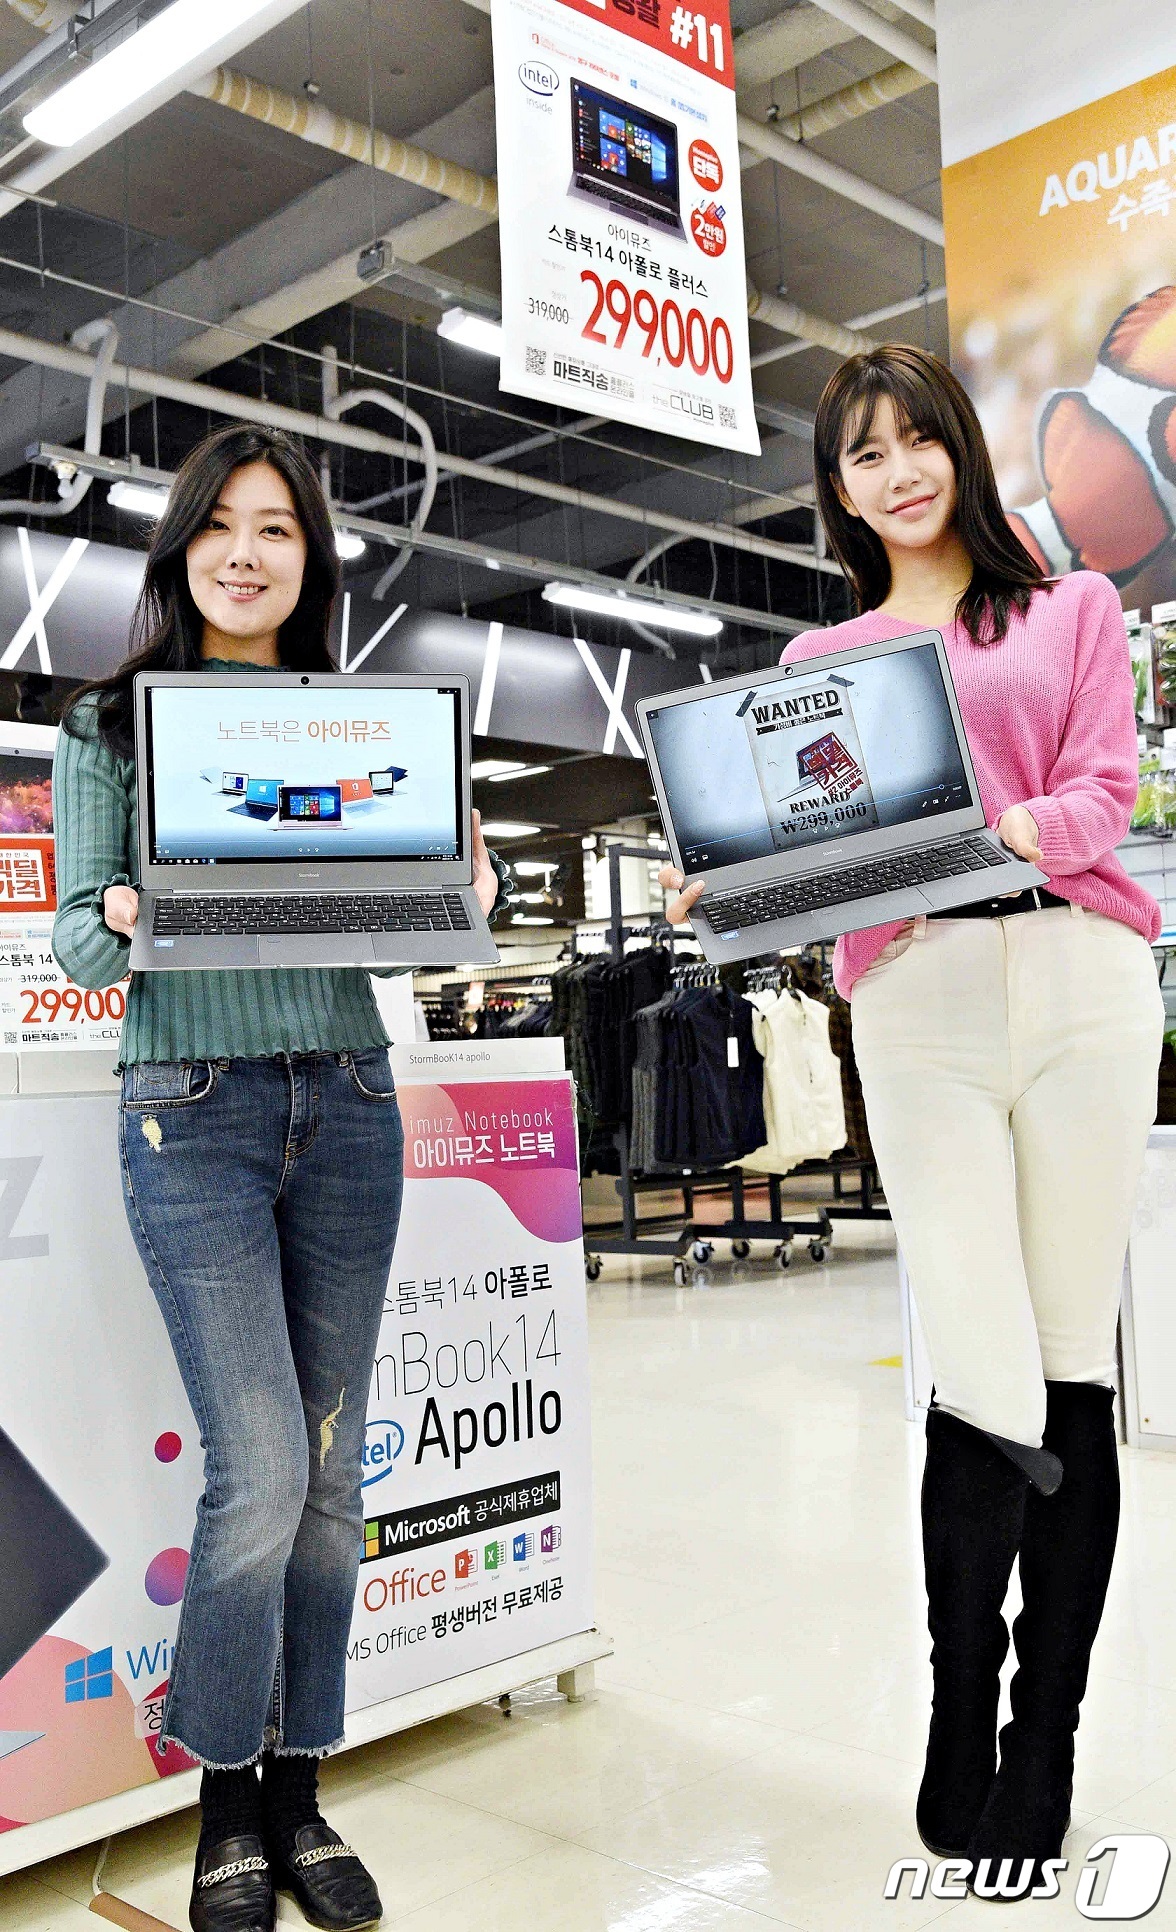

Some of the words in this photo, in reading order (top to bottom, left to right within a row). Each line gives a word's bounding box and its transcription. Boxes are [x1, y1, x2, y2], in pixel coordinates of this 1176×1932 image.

[670, 5, 724, 72] #11
[523, 63, 553, 88] intel
[1039, 124, 1176, 216] AQUAR
[1107, 178, 1176, 232] 수족
[607, 224, 652, 252] 아이뮤즈
[694, 214, 724, 244] 2만원
[548, 224, 614, 263] 스톰북14
[619, 250, 663, 280] 아폴로
[667, 267, 709, 299] 플러스
[528, 297, 569, 324] 319,000
[580, 269, 733, 384] 299,000
[553, 360, 609, 391] 마트직송
[670, 394, 714, 421] CLUB
[751, 689, 840, 724] WANTED
[217, 720, 301, 742] 노트북은
[307, 720, 391, 743] 아이뮤즈
[789, 789, 850, 814] REWARD
[0, 953, 34, 966] 스톰북
[39, 954, 53, 964] 14
[21, 974, 57, 984] 319,000
[20, 987, 126, 1024] 299,00
[22, 1032, 59, 1042] 마트직송
[465, 1052, 491, 1063] apollo
[409, 1115, 454, 1135] imuz
[465, 1107, 554, 1131] Notebook
[413, 1135, 495, 1168] 아이뮤즈
[500, 1131, 556, 1162] 노트북
[485, 1263, 552, 1300] 아폴로
[414, 1379, 562, 1470] Apollo
[362, 1433, 392, 1467] tel
[385, 1505, 470, 1546] Microsoft
[473, 1481, 558, 1521] 공식제휴업체
[363, 1568, 447, 1612] Office
[376, 1623, 427, 1654] Office
[431, 1596, 498, 1639] 평생버전
[501, 1576, 564, 1615] 무료제공
[144, 1698, 164, 1729] 정
